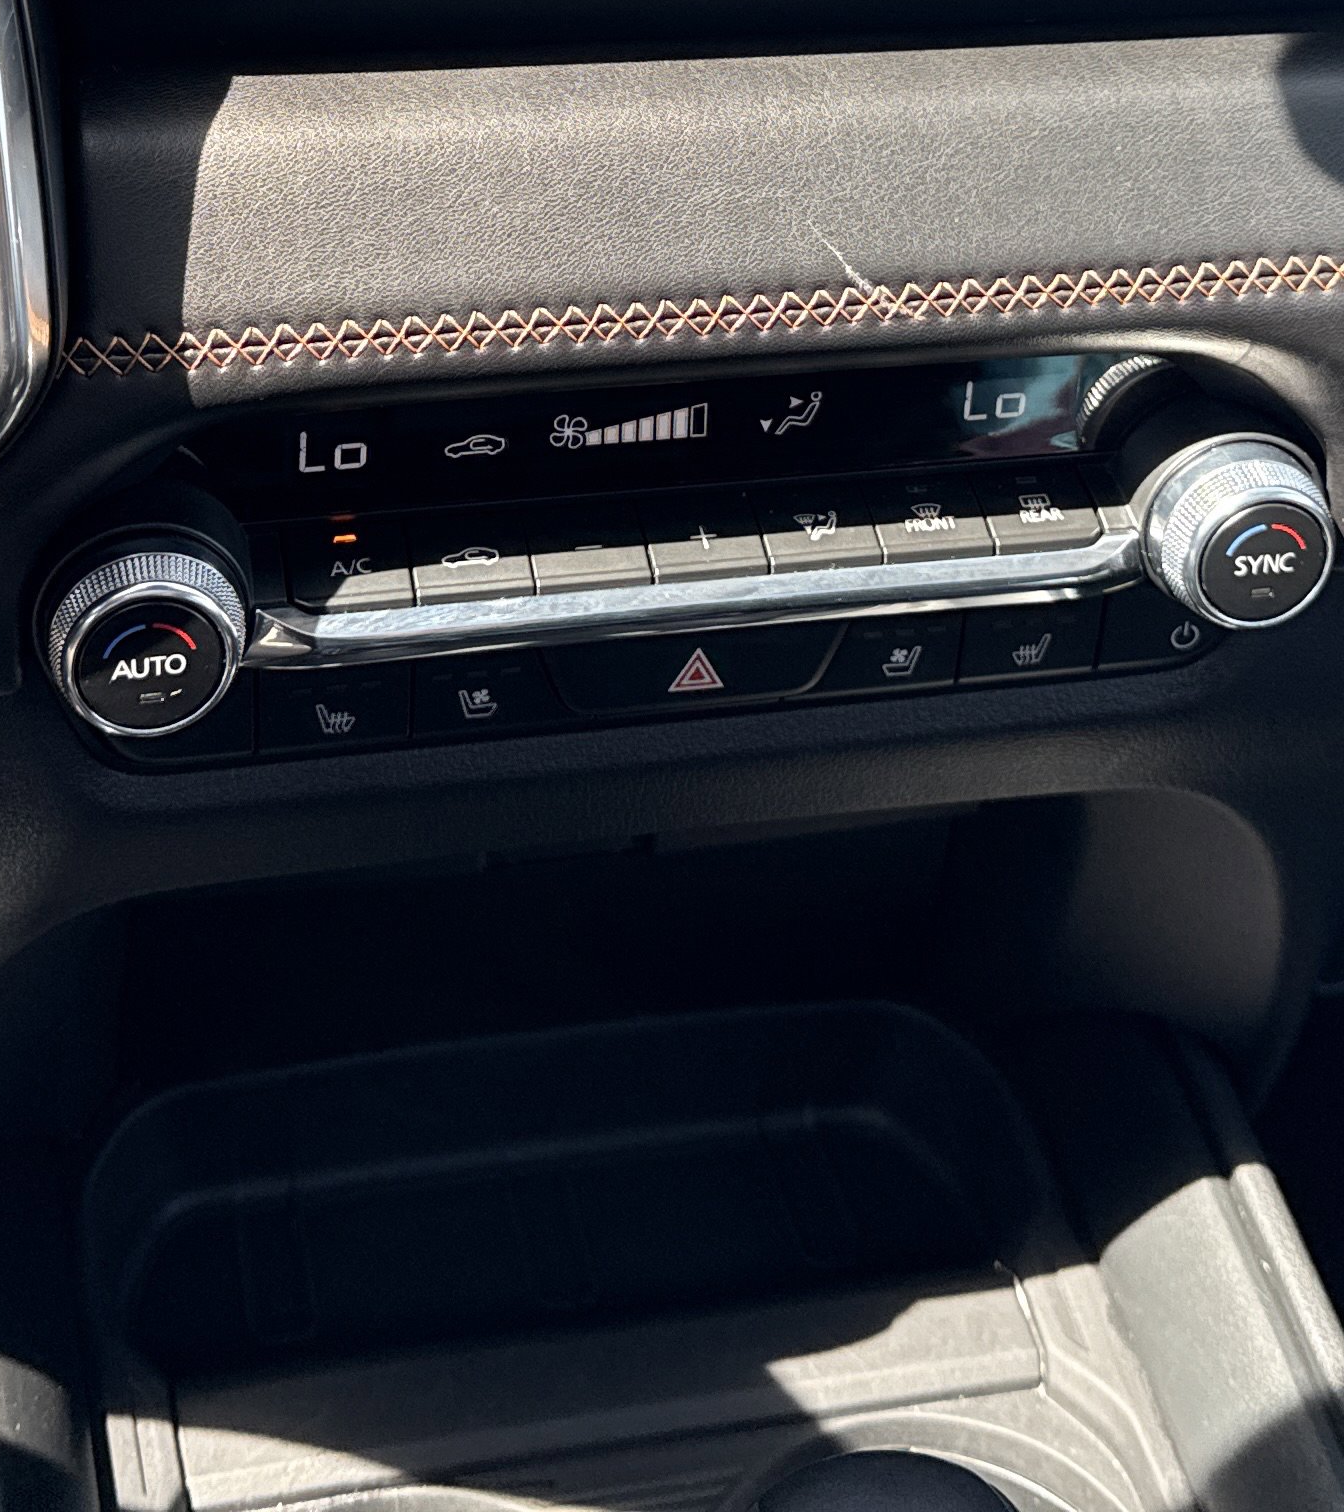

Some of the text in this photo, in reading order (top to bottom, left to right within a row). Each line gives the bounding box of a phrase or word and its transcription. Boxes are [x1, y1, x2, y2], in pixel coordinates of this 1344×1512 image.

[905, 515, 956, 533] FRONT
[1019, 507, 1065, 524] REAR
[330, 557, 372, 577] A/C
[1233, 551, 1296, 578] SYNC
[110, 652, 187, 683] AUTO
